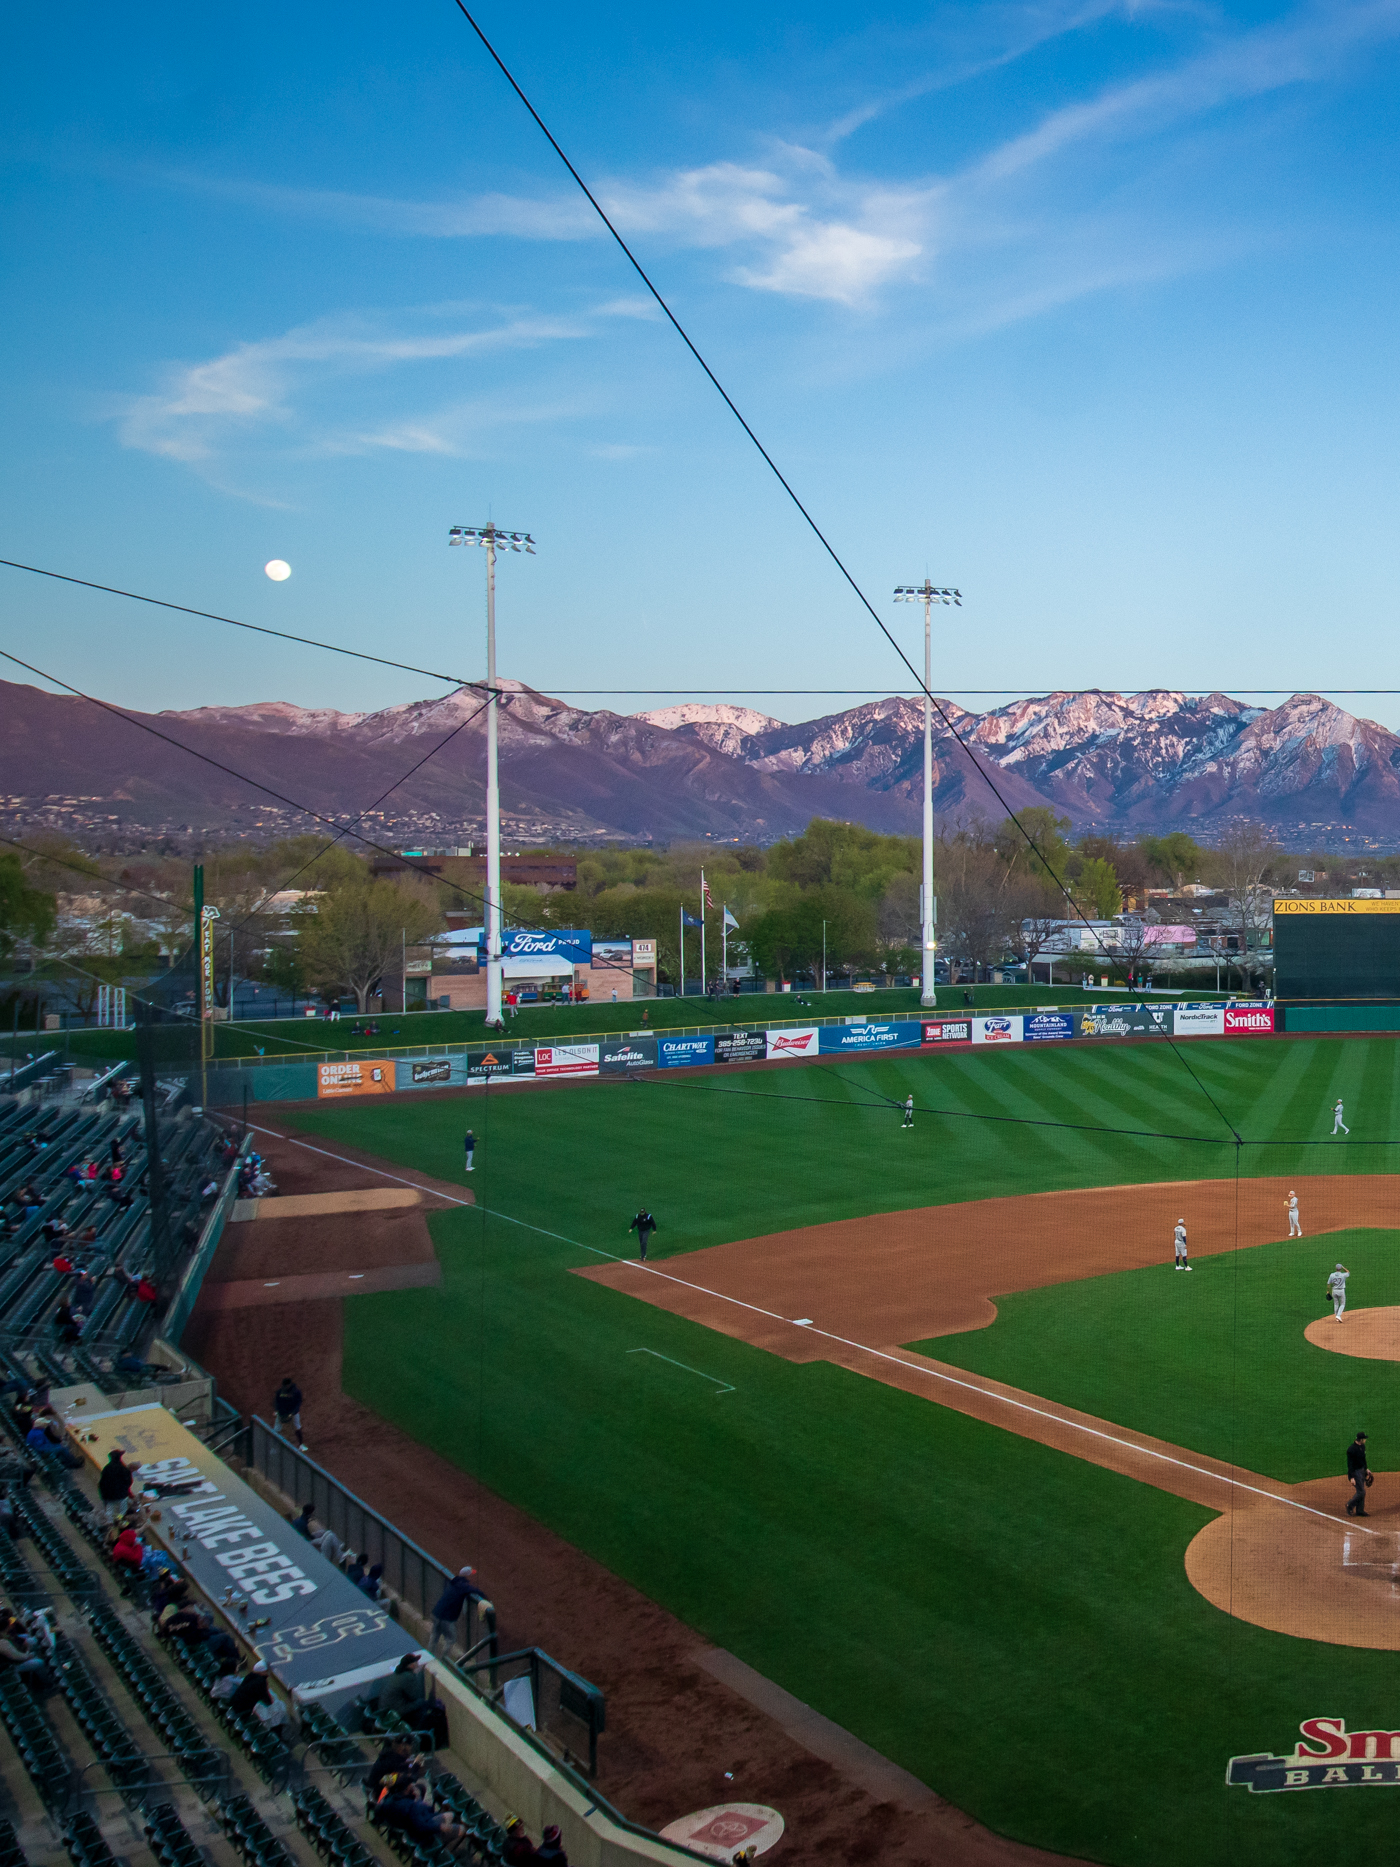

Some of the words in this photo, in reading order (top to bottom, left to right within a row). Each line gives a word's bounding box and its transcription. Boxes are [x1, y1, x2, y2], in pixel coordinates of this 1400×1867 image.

[1275, 902, 1316, 912] ZIONS
[1320, 902, 1357, 912] BANK
[510, 934, 556, 952] Ford
[204, 957, 212, 977] MOR
[204, 981, 212, 1009] FOWL
[1226, 1012, 1271, 1027] Smith's
[942, 1024, 967, 1033] SPORTS
[987, 1019, 1010, 1033] Farr
[1093, 1018, 1131, 1036] Healthy
[733, 1032, 749, 1040] TEXT
[841, 1035, 875, 1044] AMERICA
[877, 1033, 899, 1042] FIRST
[942, 1031, 967, 1040] NETWORK
[663, 1041, 708, 1052] CHARTWAY
[777, 1038, 810, 1047] Budweiser
[538, 1053, 552, 1061] LOC
[604, 1051, 643, 1063] Safelite
[626, 1059, 654, 1067] AutoGlass
[321, 1064, 360, 1075] ORDER
[470, 1065, 510, 1073] SPECTRUM
[321, 1074, 363, 1085] ONLINE
[1333, 1278, 1342, 1287] 27
[170, 1494, 263, 1550] LAKE
[215, 1541, 318, 1606] BEES
